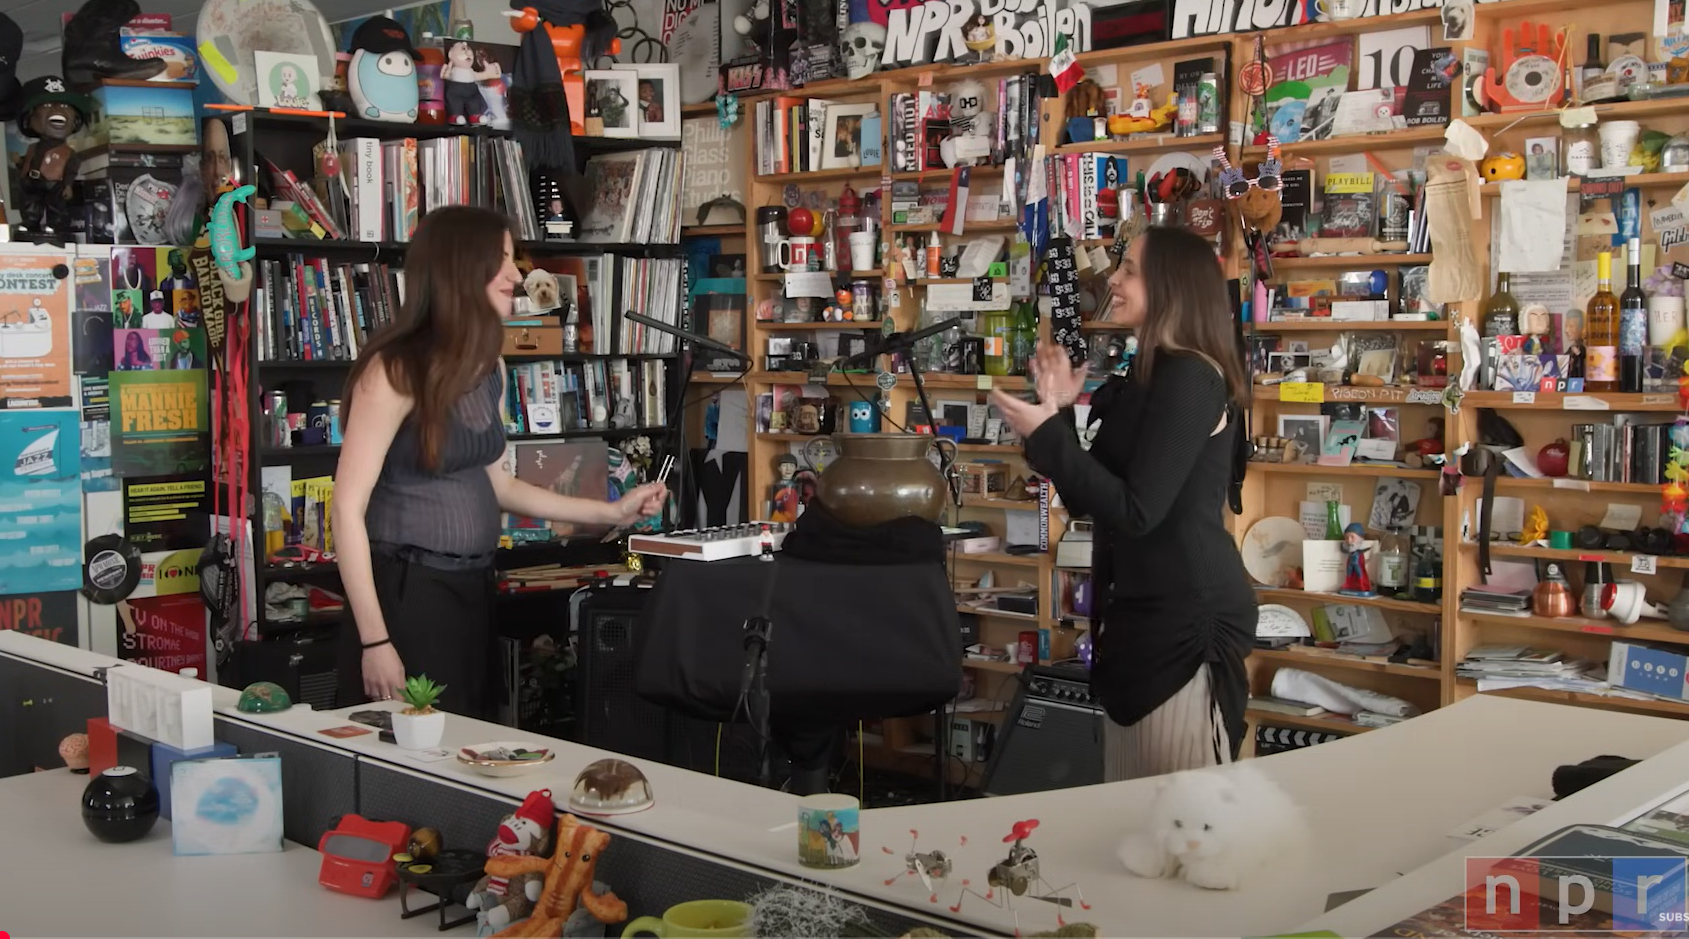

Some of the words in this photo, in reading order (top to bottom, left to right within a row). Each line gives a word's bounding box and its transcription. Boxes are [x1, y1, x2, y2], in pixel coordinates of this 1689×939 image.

[881, 0, 975, 64] NPR
[994, 2, 1092, 58] Boilen
[1363, 45, 1418, 89] 10
[727, 64, 763, 91] KISS
[1407, 117, 1421, 125] BOB
[1422, 115, 1448, 124] BOILEN
[365, 141, 373, 158] tiny
[684, 145, 730, 165] Glass
[862, 147, 880, 159] LOUIE
[1327, 178, 1372, 186] PLAYBILL
[1192, 207, 1214, 219] Don't
[1085, 210, 1095, 238] CALL
[1192, 217, 1213, 228] Trip
[1054, 258, 1072, 270] 9:30
[0, 279, 56, 290] ONTEST
[1055, 283, 1074, 295] 9:30
[1055, 306, 1076, 318] 9:30
[1655, 310, 1678, 323] HER
[309, 299, 321, 348] RECORDS
[1544, 381, 1577, 391] npr
[1331, 388, 1375, 399] PIGEON
[1380, 391, 1402, 399] PIT
[121, 392, 197, 411] MANNIE
[122, 409, 197, 432] FRESH
[21, 452, 50, 466] JAZZ
[1040, 482, 1049, 551] COMMONWEALTH
[151, 615, 168, 632] ON
[170, 622, 184, 636] THE
[122, 632, 181, 651] STROMAE
[1017, 718, 1043, 729] Roland
